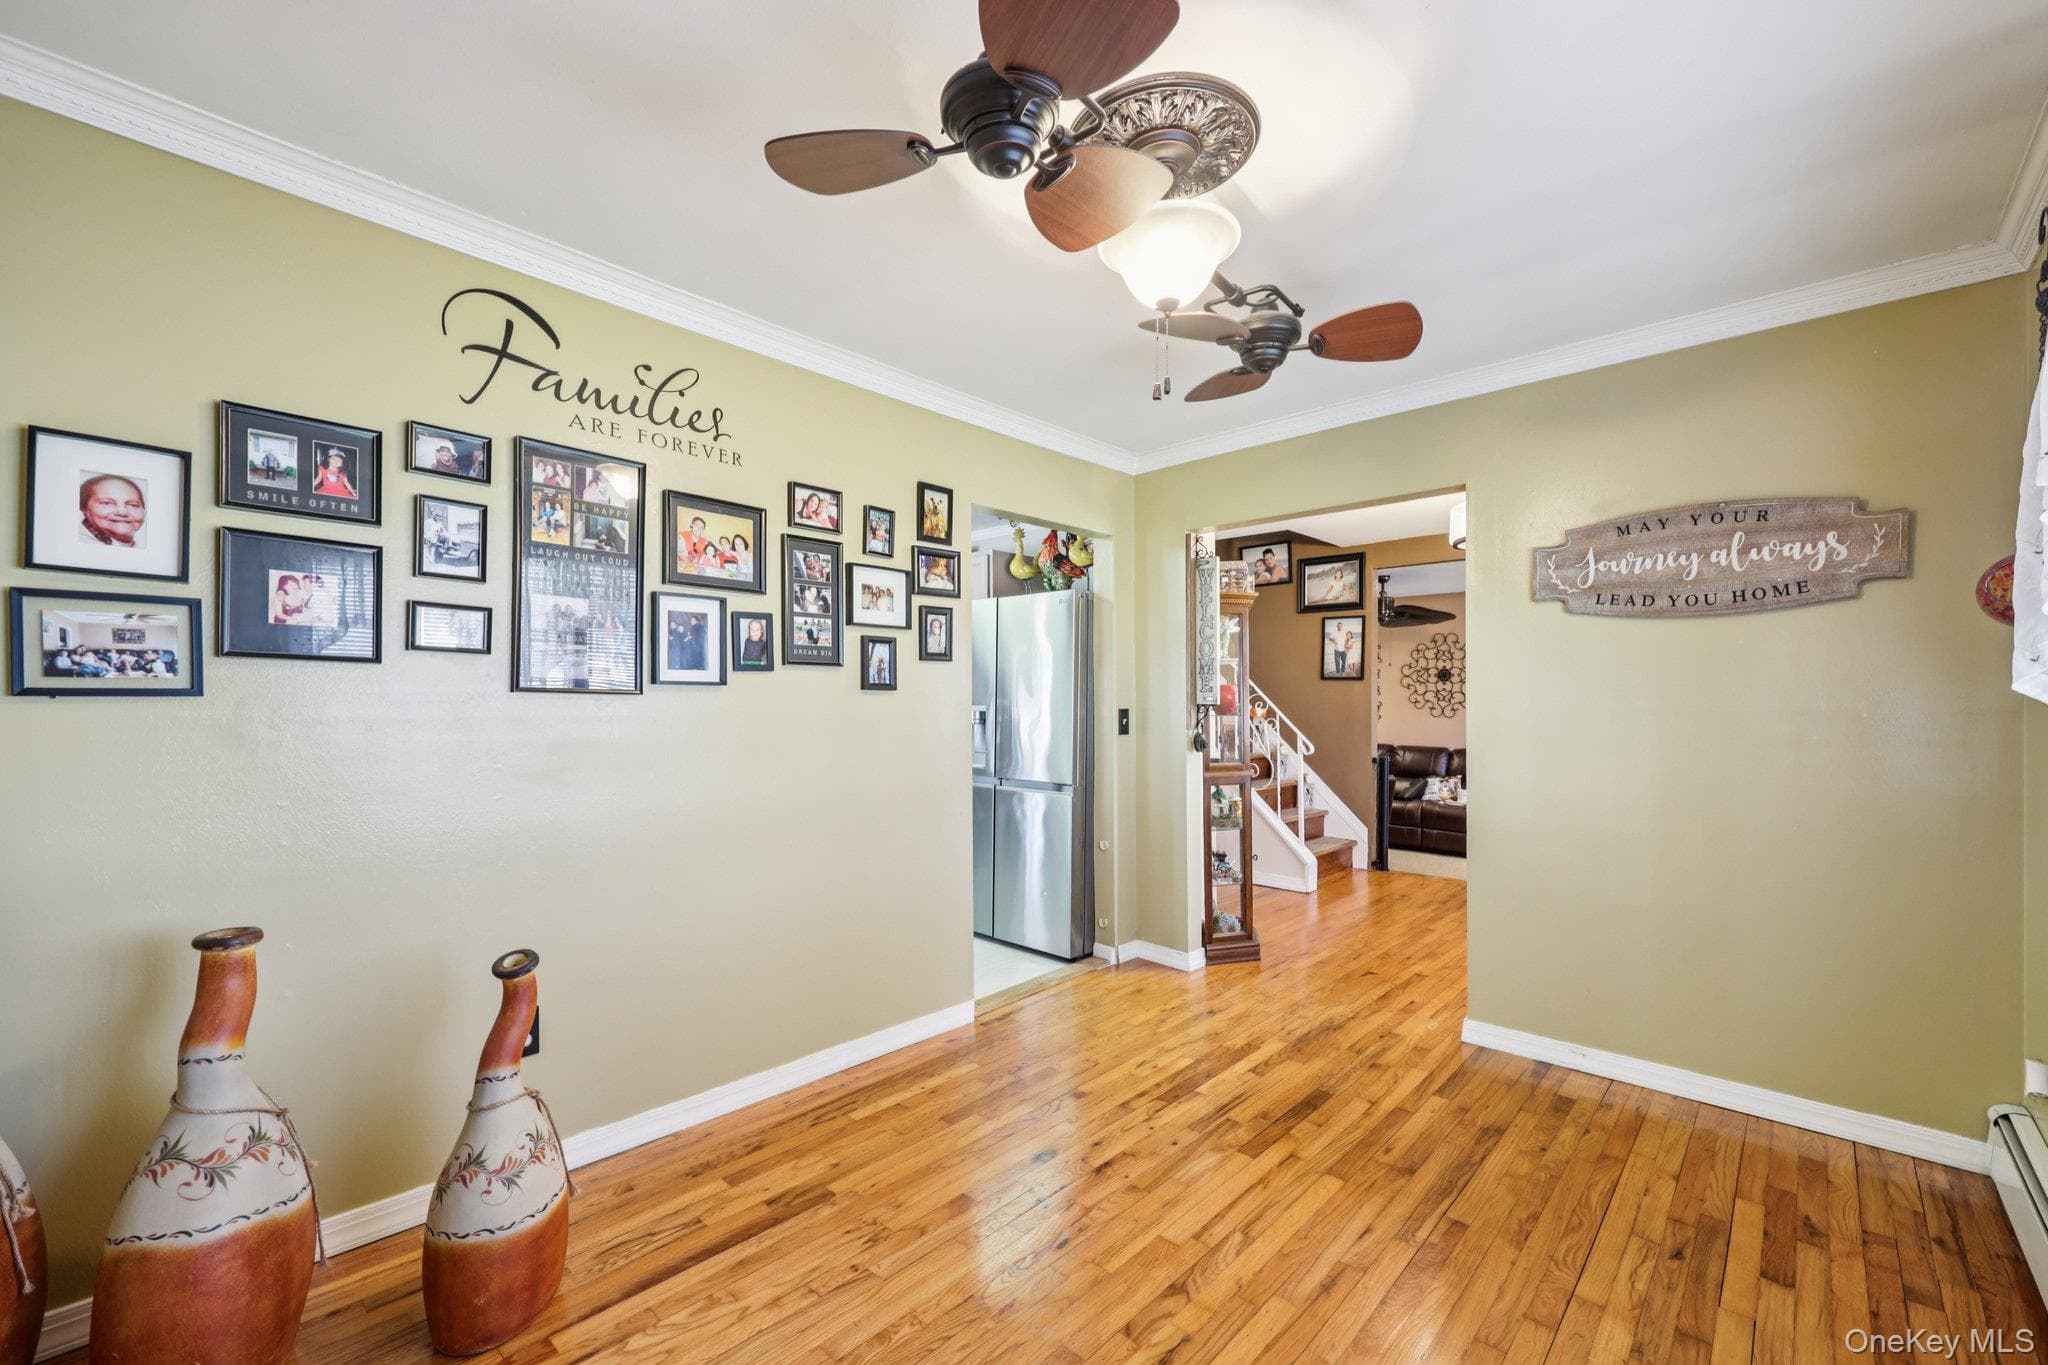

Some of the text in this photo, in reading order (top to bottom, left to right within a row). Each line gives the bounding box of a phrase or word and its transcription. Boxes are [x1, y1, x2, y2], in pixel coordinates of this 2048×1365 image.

[441, 288, 732, 442] Families
[568, 414, 743, 467] ARE FOREVER
[246, 490, 359, 513] SMILE OFTEN
[573, 502, 630, 519] BE HAPPY
[1615, 509, 1771, 538] MAY YOUR
[530, 547, 629, 567] LAUGH OUT LOUD
[1575, 531, 1851, 589] Journey always
[1595, 580, 1812, 607] LEAD YOU HOME
[1197, 566, 1214, 693] WELCOME
